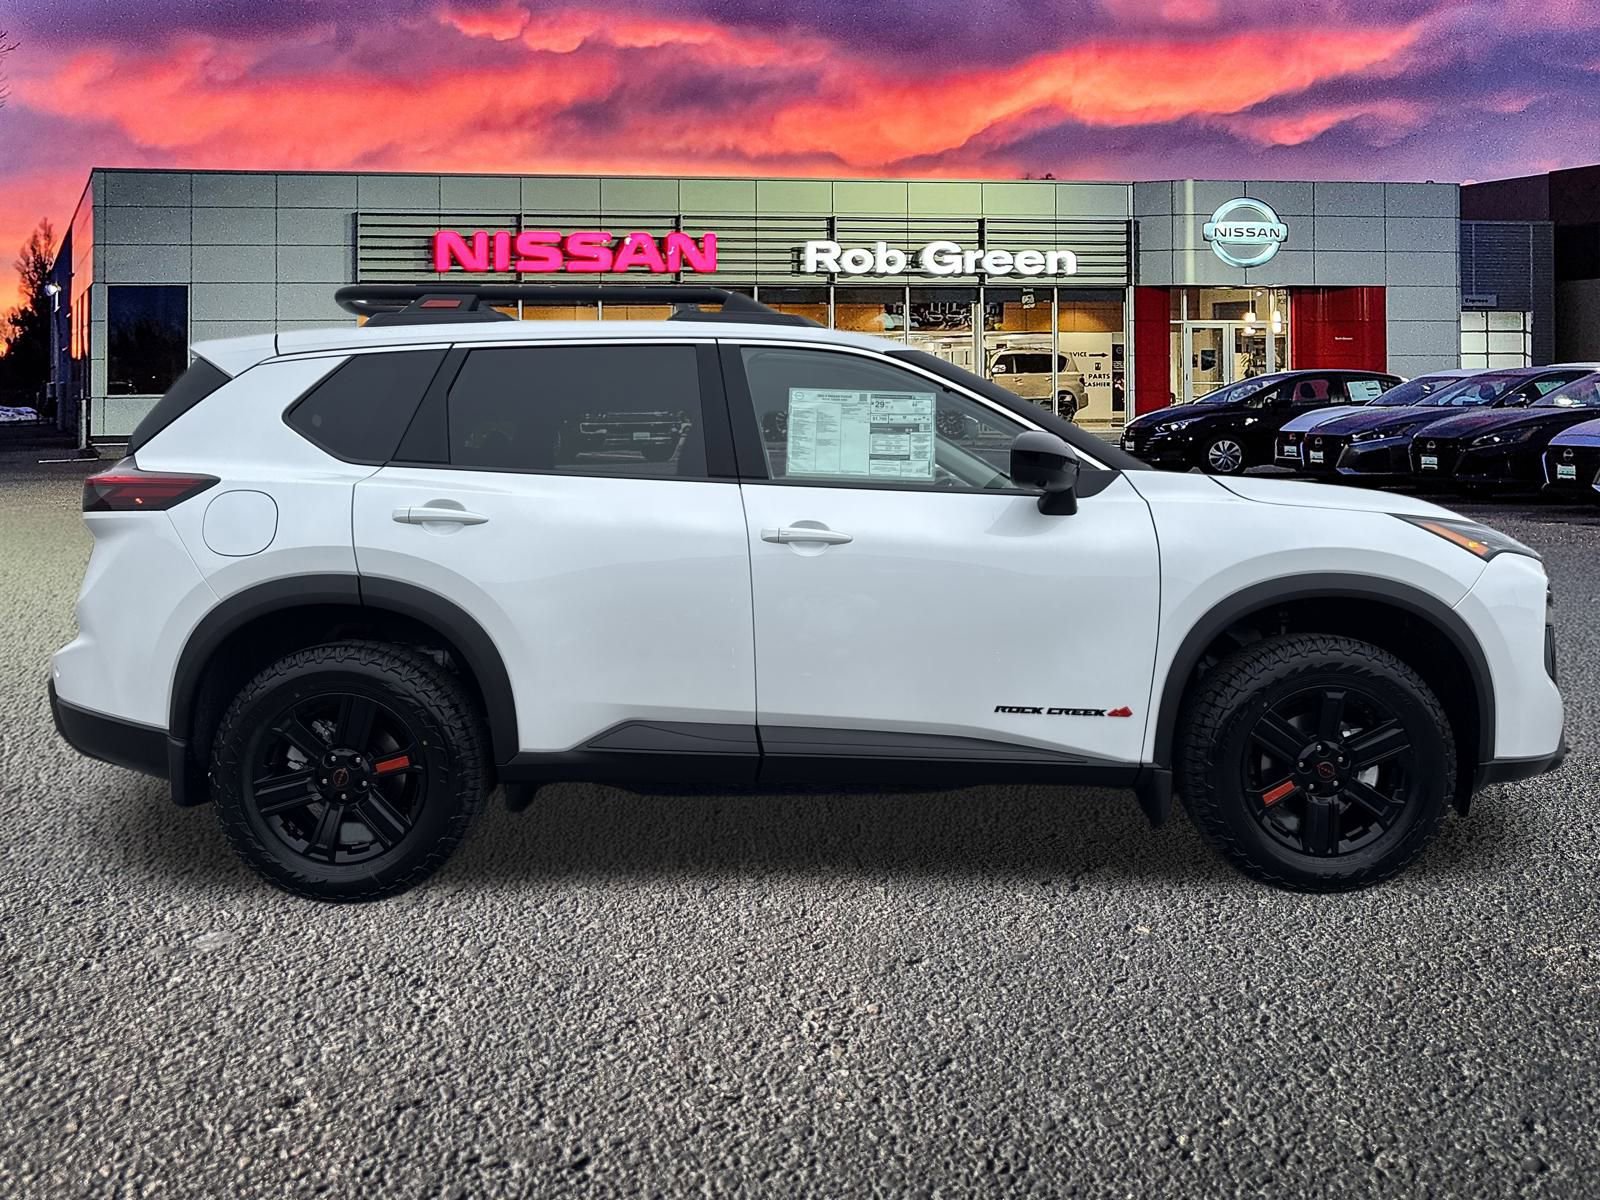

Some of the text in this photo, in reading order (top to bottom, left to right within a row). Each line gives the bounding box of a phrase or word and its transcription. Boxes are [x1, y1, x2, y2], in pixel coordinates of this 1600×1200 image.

[1214, 227, 1280, 238] NISSAN
[433, 230, 718, 274] NISSAN
[804, 240, 1078, 276] Rob Green
[994, 705, 1107, 717] ROCK CREEK
